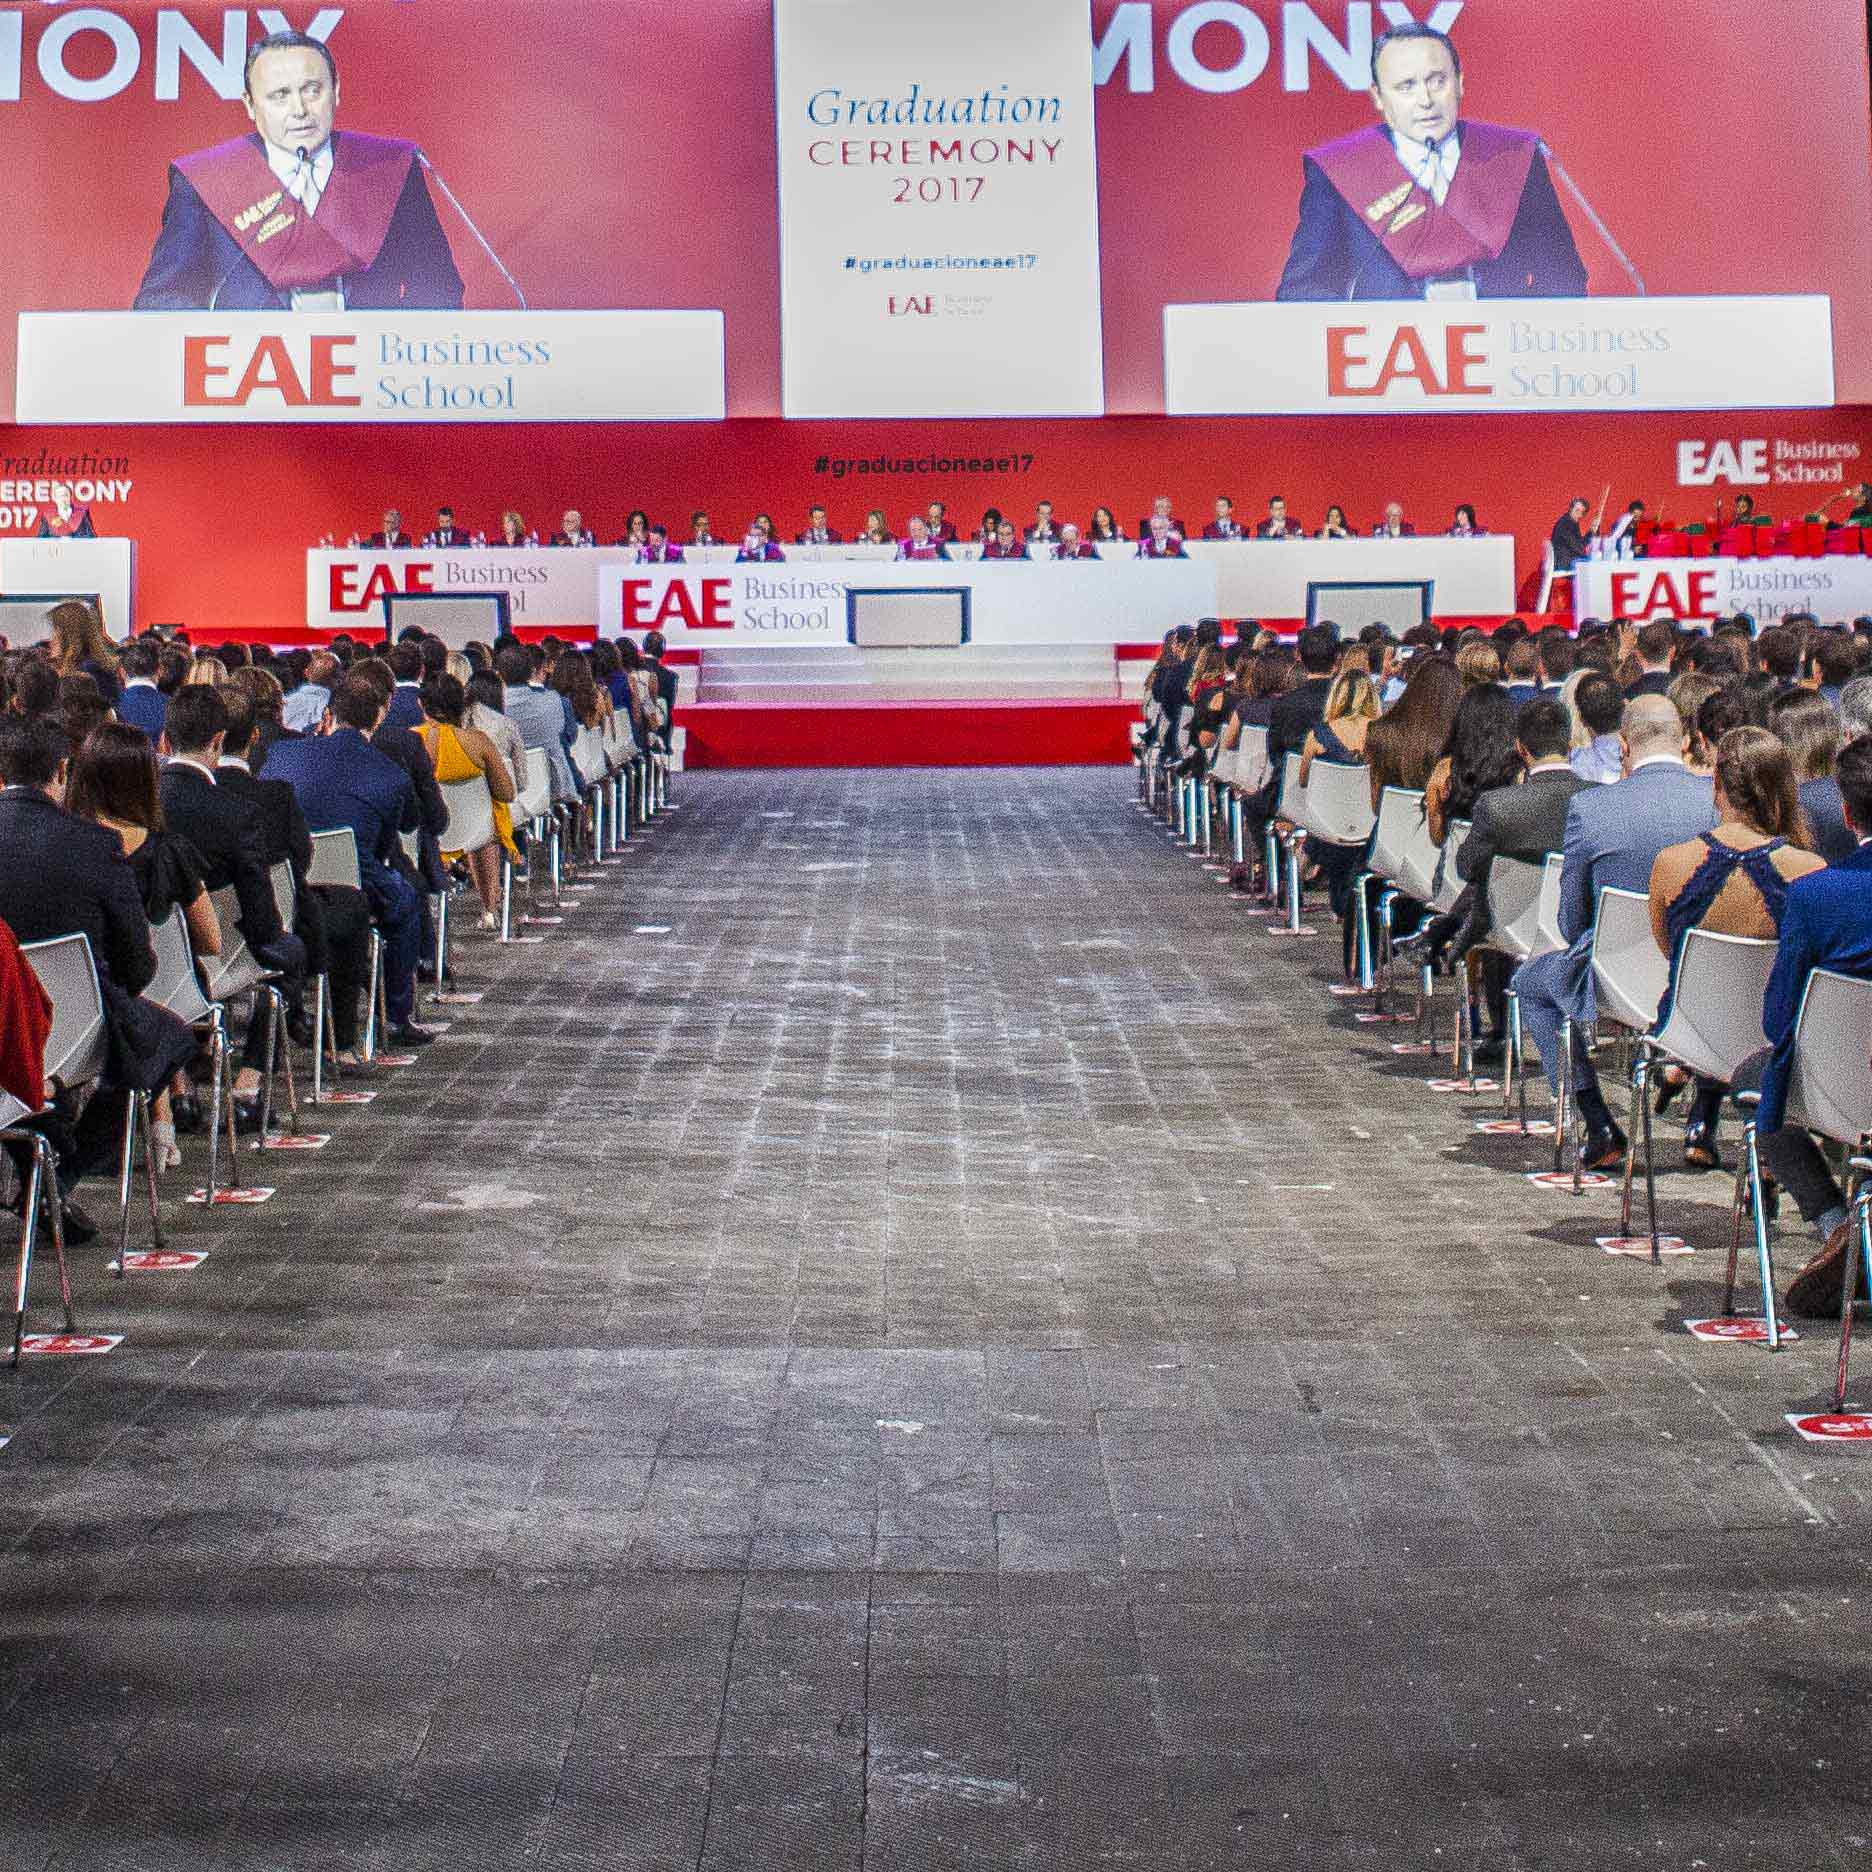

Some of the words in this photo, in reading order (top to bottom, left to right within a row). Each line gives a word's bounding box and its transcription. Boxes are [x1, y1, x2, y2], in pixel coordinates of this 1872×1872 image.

[807, 83, 1062, 125] Graduation
[808, 138, 1064, 166] CEREMONY
[893, 176, 985, 203] 2017
[844, 253, 1038, 275] #graduacioneae17
[887, 295, 938, 316] EAE
[184, 334, 362, 407] EAE
[378, 333, 552, 366] Business
[1327, 324, 1493, 397] EAE
[1510, 321, 1672, 353] Business
[378, 375, 516, 409] School
[1511, 361, 1641, 398] School
[814, 453, 1034, 478] #graduacioneae17
[1677, 439, 1771, 486] EAE
[1775, 439, 1861, 459] Business
[1775, 462, 1844, 482] School
[446, 562, 549, 585] Business
[622, 577, 735, 630] EAE
[745, 576, 852, 601] Business
[1610, 569, 1721, 620] EAE
[1729, 569, 1833, 591] Business
[744, 606, 831, 632] School
